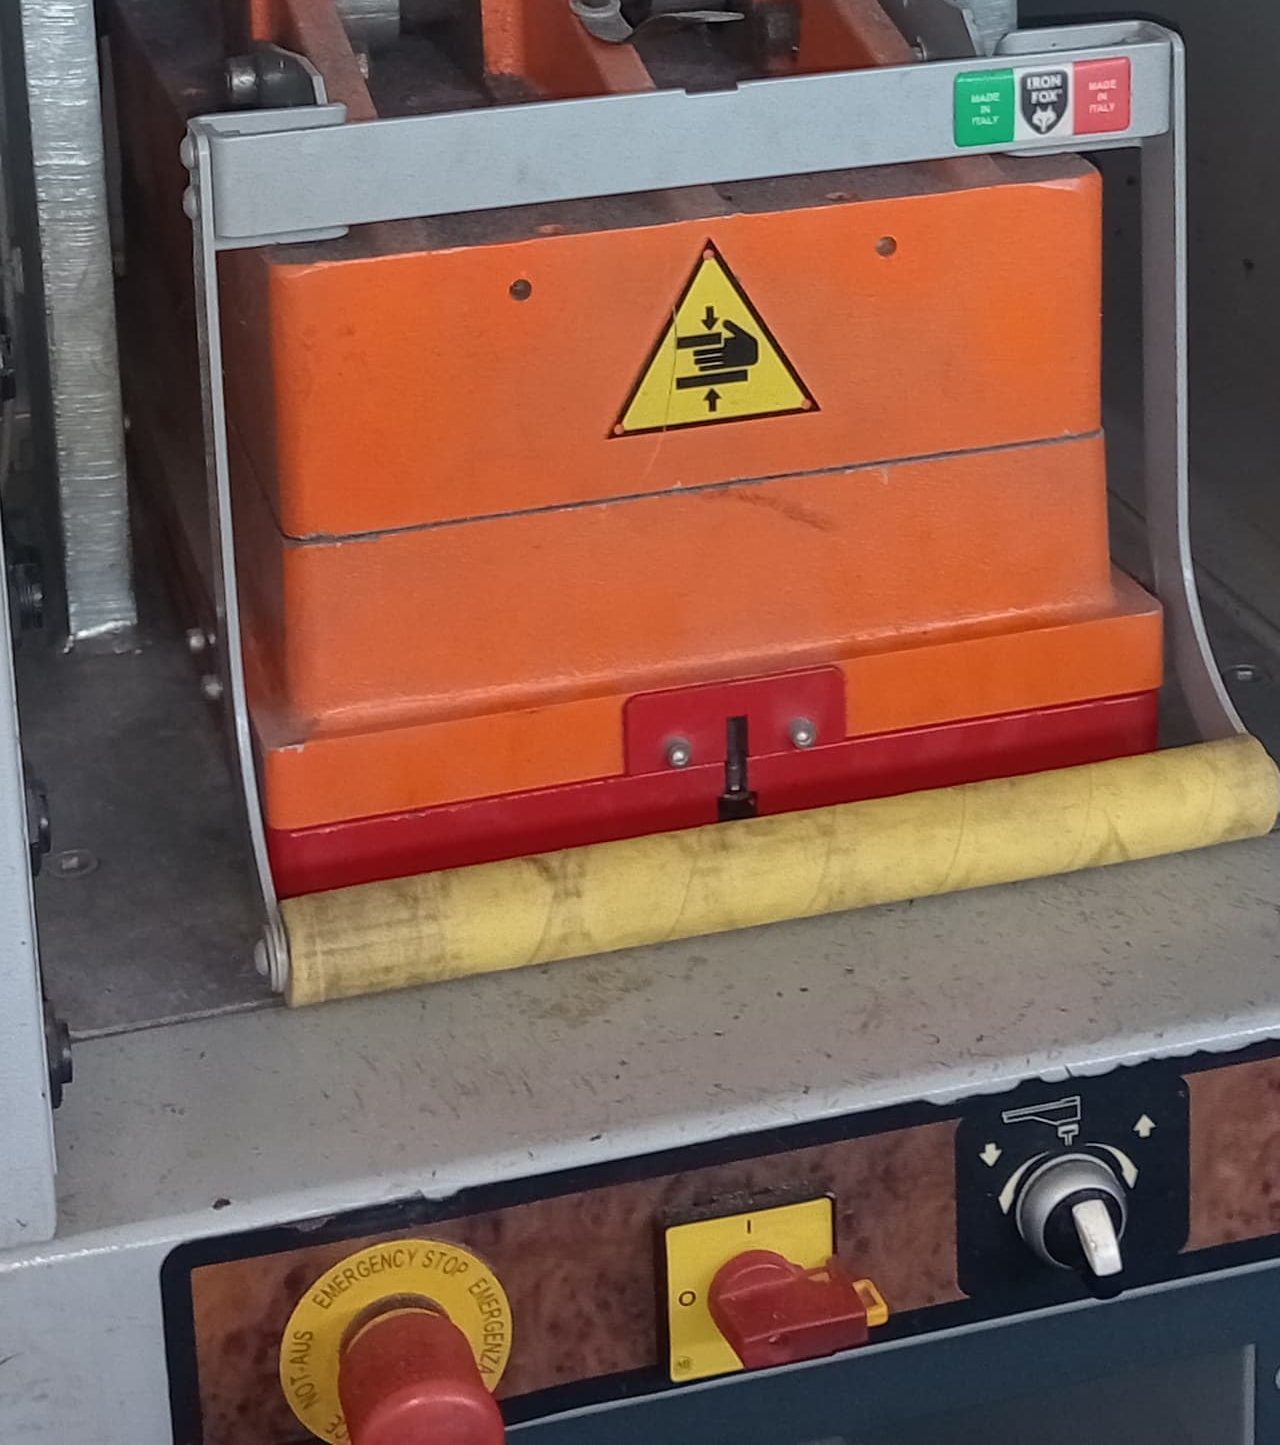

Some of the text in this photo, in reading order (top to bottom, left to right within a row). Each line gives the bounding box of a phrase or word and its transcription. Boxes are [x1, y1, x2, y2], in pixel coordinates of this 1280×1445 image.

[1026, 74, 1062, 90] IRON
[1088, 79, 1117, 90] MADE
[971, 92, 1000, 103] MADE
[1097, 92, 1108, 101] IN
[980, 105, 991, 114] IN
[1088, 103, 1116, 113] ITALY
[972, 115, 1000, 125] ITALY
[312, 1248, 470, 1310] EMERGENCY STOP
[467, 1277, 506, 1376] EMERGENZA
[290, 1330, 320, 1411] NOT-AUS
